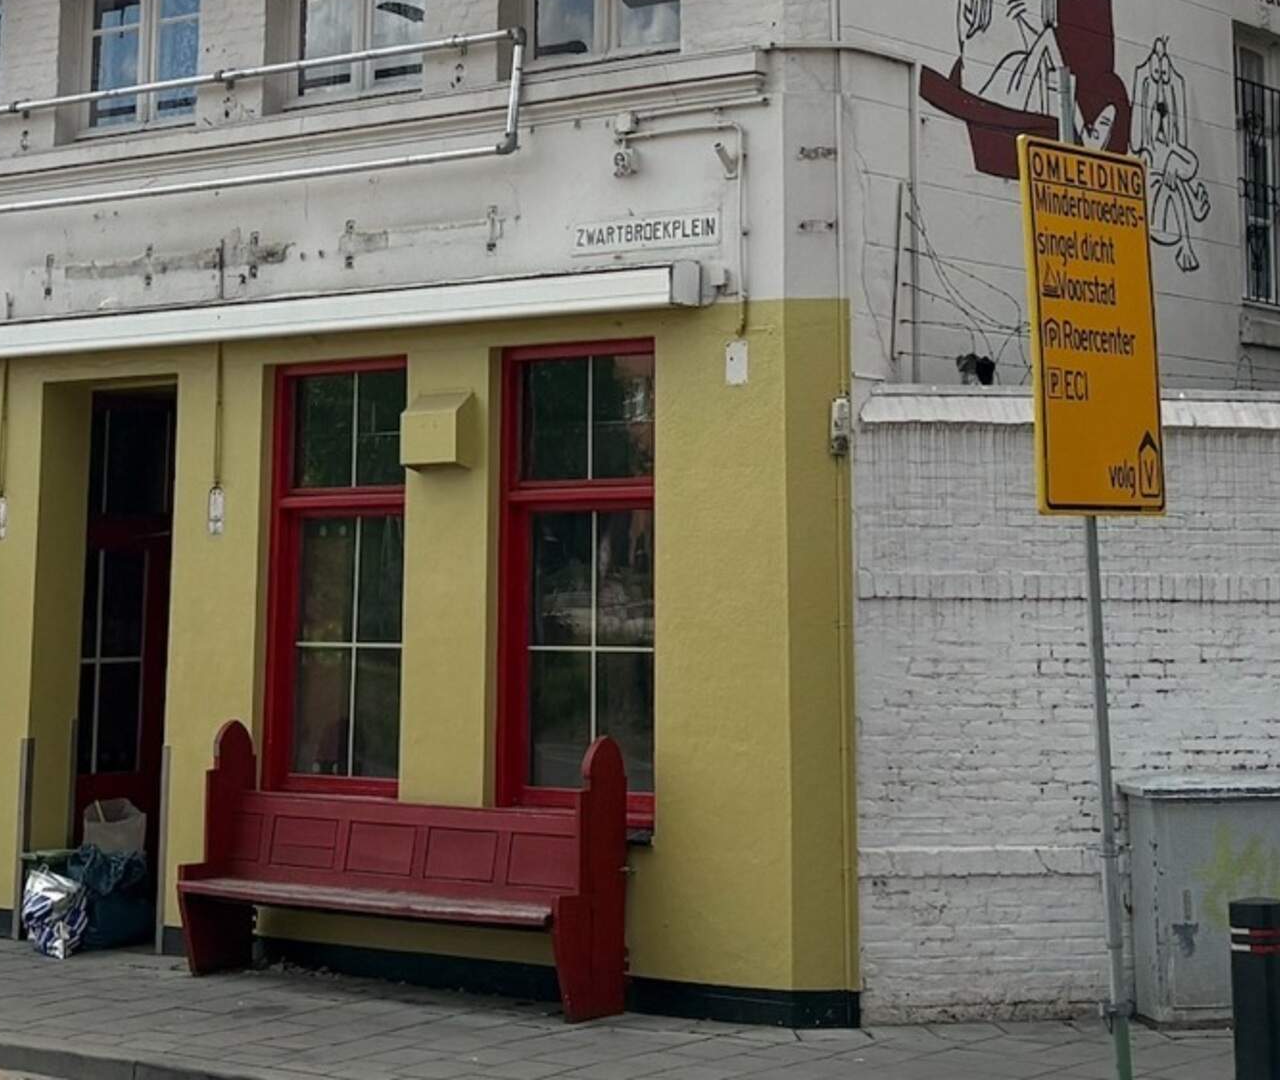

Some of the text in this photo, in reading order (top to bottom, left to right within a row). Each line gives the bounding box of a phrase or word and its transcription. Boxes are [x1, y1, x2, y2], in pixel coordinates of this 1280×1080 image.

[1032, 151, 1141, 196] OMLEIDING
[1034, 182, 1144, 228] Minderbroeders-
[576, 217, 717, 248] ZWARTBROEKPLEIN
[1037, 226, 1115, 267] singel dicht
[1056, 270, 1116, 306] Voorstad
[1062, 319, 1136, 356] Roercenter
[1064, 370, 1089, 400] ECI
[1108, 458, 1154, 498] volg V
